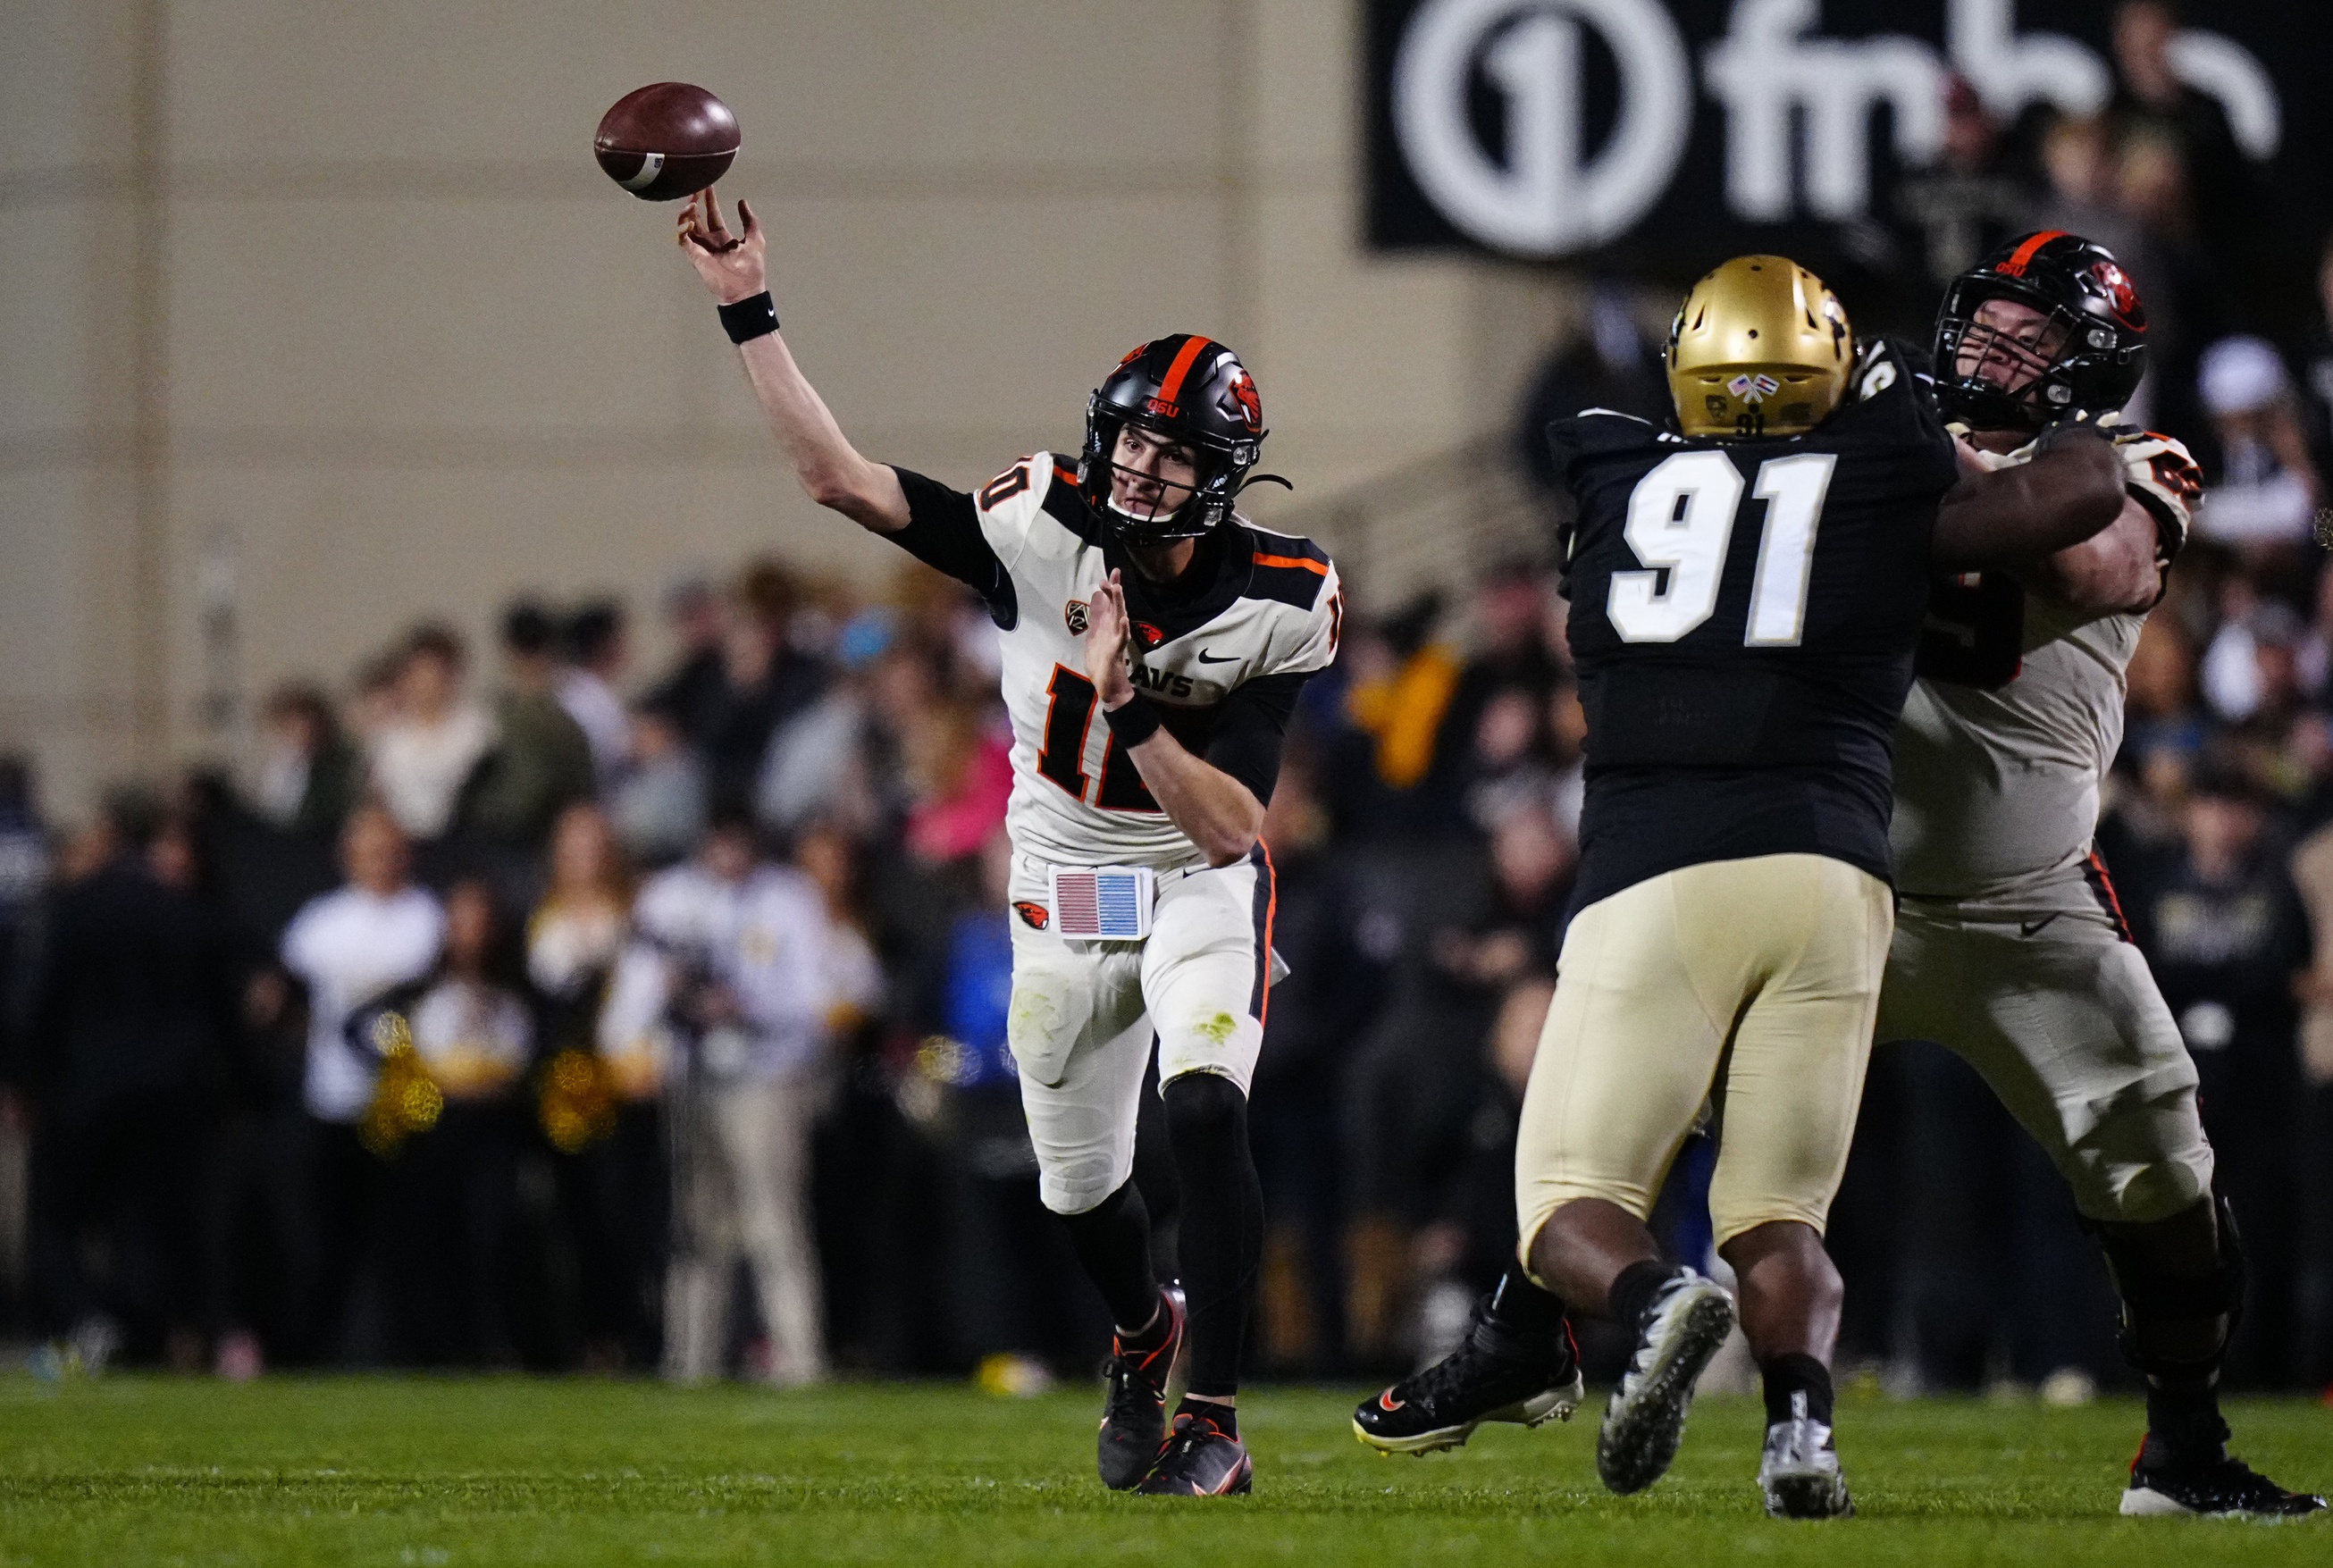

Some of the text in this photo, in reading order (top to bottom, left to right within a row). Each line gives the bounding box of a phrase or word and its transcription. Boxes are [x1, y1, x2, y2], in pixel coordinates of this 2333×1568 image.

[1994, 262, 2027, 278] OSU
[1146, 398, 1179, 418] OSU
[1606, 449, 1839, 648] 91
